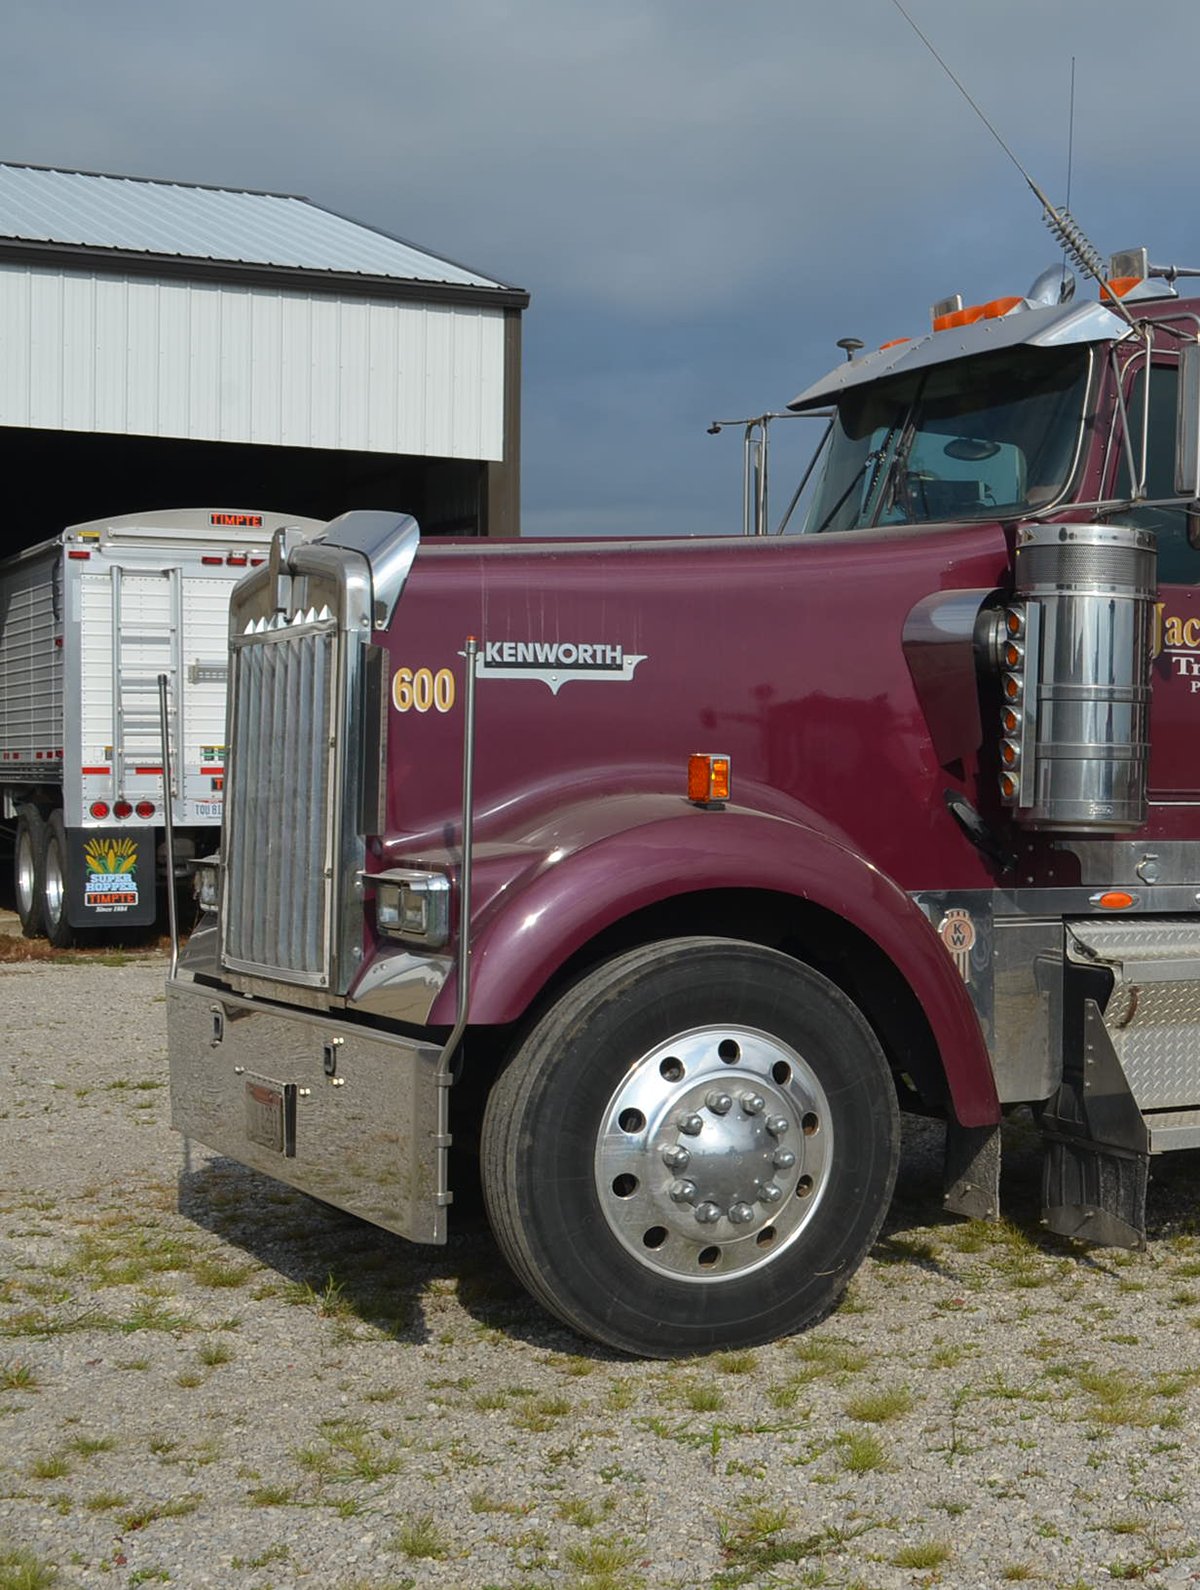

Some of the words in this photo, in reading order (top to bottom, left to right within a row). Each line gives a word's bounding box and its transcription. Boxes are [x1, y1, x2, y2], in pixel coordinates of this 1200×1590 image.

[212, 513, 262, 528] TIMPTE
[485, 641, 623, 666] KENWORTH
[392, 667, 455, 713] 600
[90, 873, 133, 883] SUPER
[85, 882, 137, 892] HOPPER
[90, 893, 136, 904] TIMPTE
